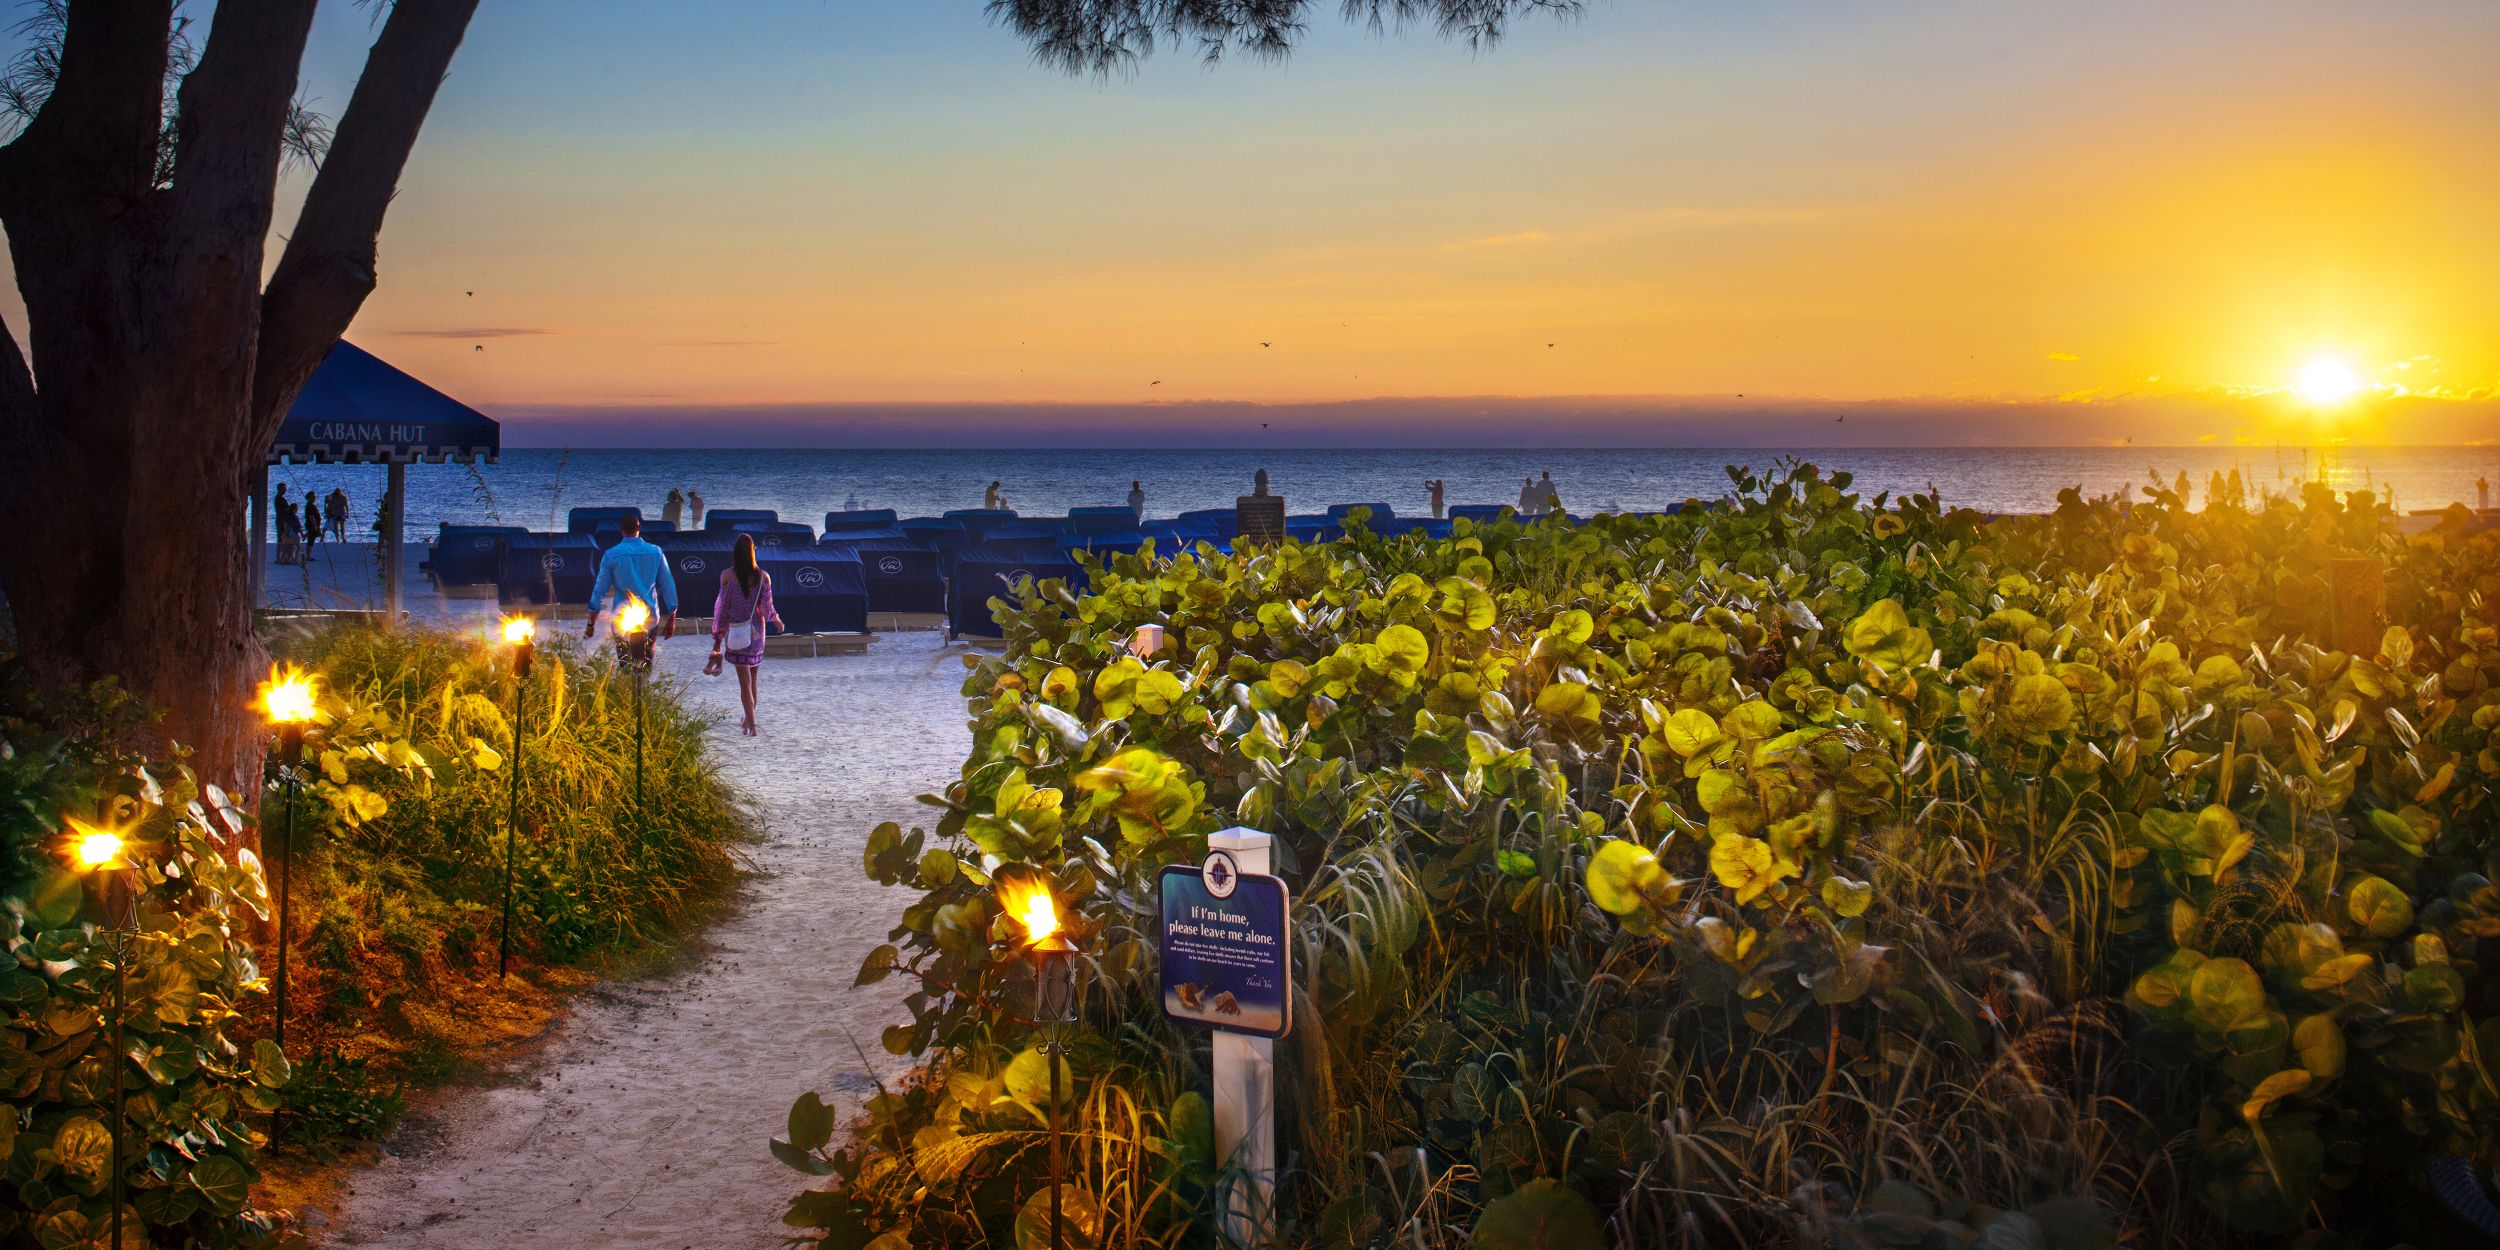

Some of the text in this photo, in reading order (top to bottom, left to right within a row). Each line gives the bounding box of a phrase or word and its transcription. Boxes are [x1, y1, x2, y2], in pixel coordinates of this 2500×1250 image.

[310, 422, 426, 442] CABANA HUT
[1191, 905, 1250, 928] If I'm home,
[1169, 919, 1276, 946] please leave me alone.
